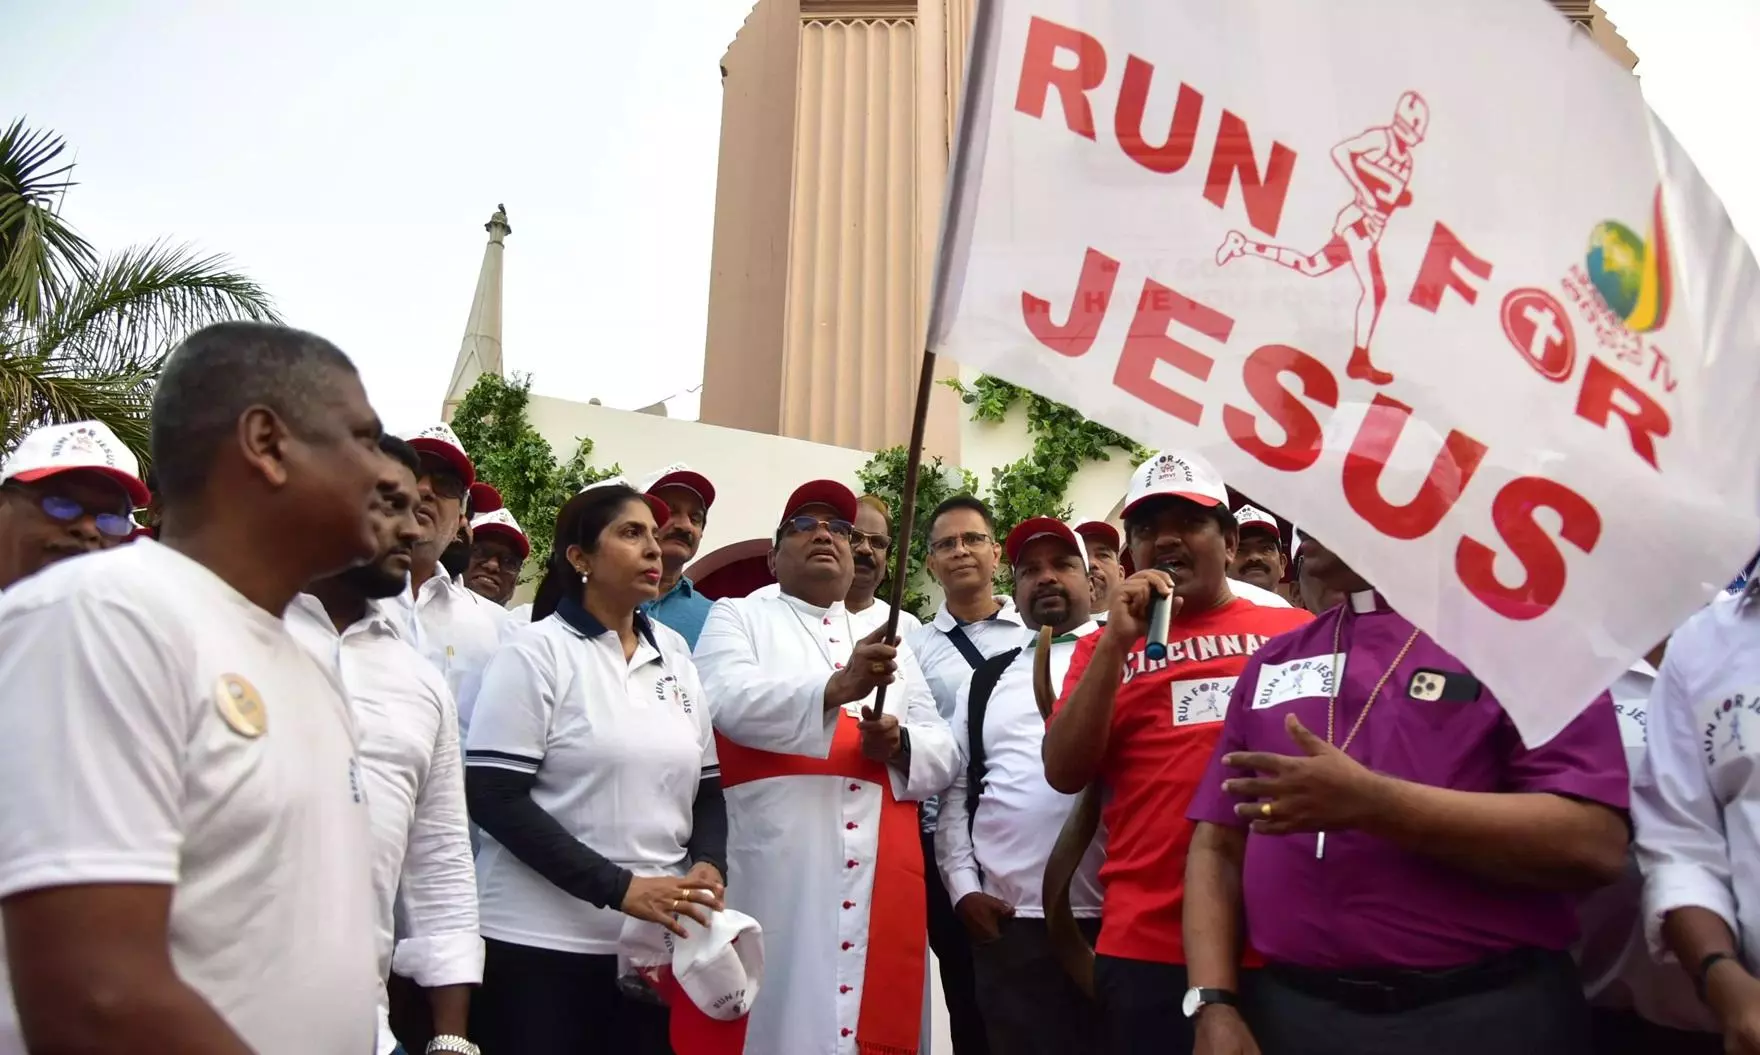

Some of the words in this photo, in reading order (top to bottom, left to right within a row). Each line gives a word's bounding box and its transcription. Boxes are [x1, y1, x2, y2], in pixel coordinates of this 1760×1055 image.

[1014, 15, 1298, 238] RUN
[1408, 219, 1672, 473] FOR
[1650, 344, 1678, 393] TV
[1021, 246, 1603, 620] JESUS
[1154, 454, 1174, 467] FOR
[1175, 458, 1193, 482] JESUS
[656, 681, 666, 700] RUN
[1178, 696, 1192, 722] RUN
[1191, 682, 1220, 697] FOR
[1260, 678, 1280, 705] RUN
[1281, 661, 1312, 676] FOR
[1313, 662, 1334, 693] JESUS
[1704, 723, 1716, 766] RUN
[1714, 693, 1744, 720] FOR
[713, 994, 733, 1009] RUN
